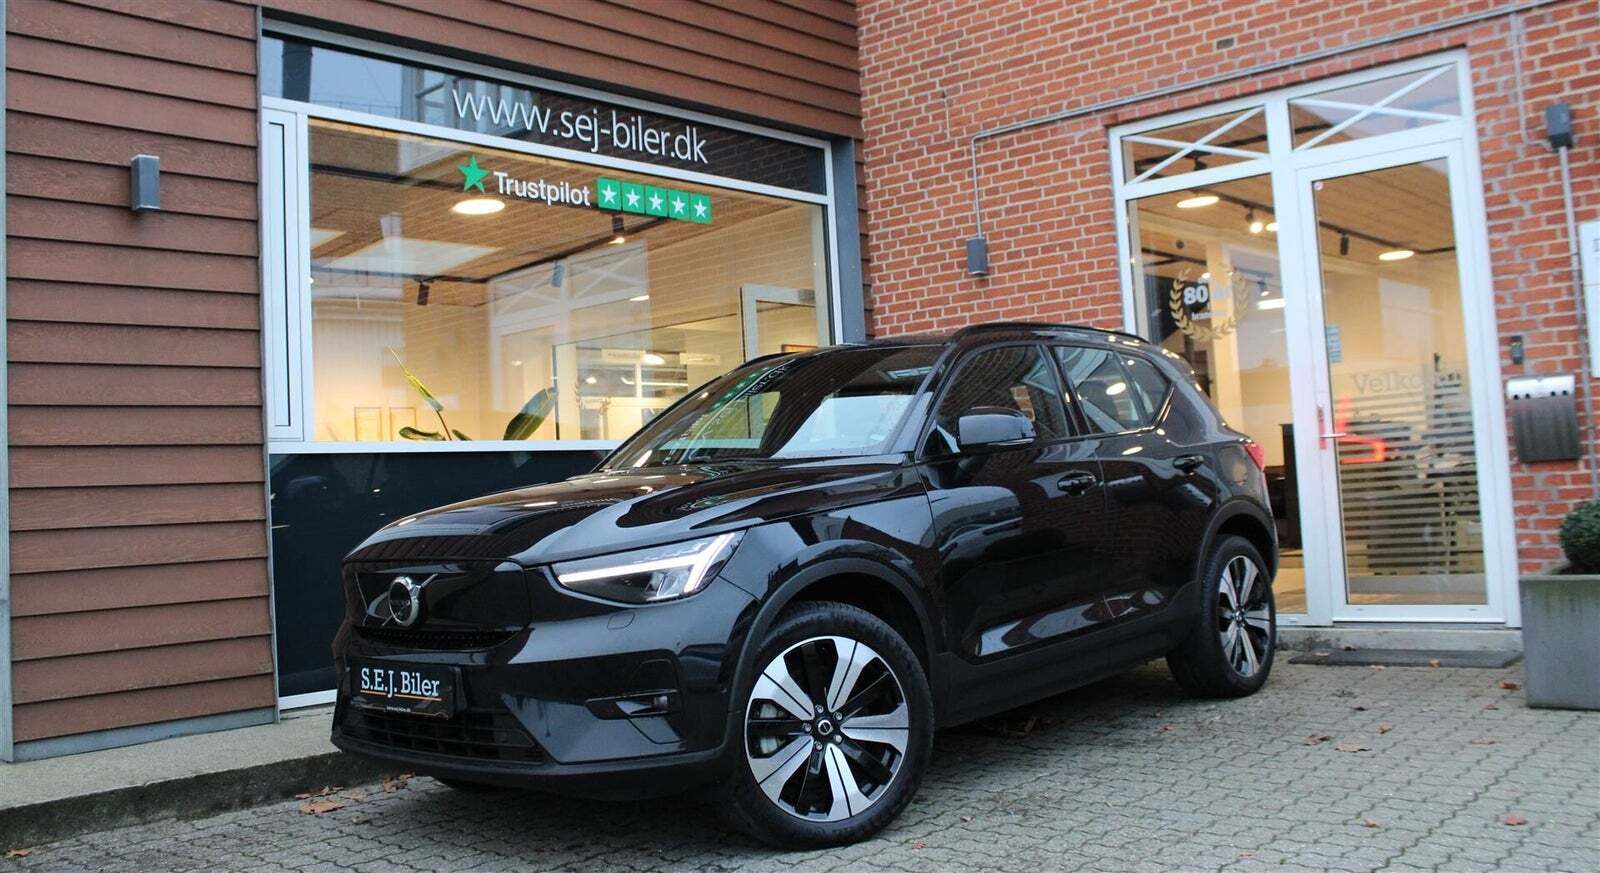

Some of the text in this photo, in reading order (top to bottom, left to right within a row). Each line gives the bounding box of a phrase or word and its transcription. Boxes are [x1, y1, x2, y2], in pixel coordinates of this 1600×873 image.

[452, 88, 709, 164] www.sej-biler.dk
[494, 171, 590, 206] Trustpilot
[1182, 284, 1210, 305] 80
[361, 667, 440, 698] S.E.J. Biler
